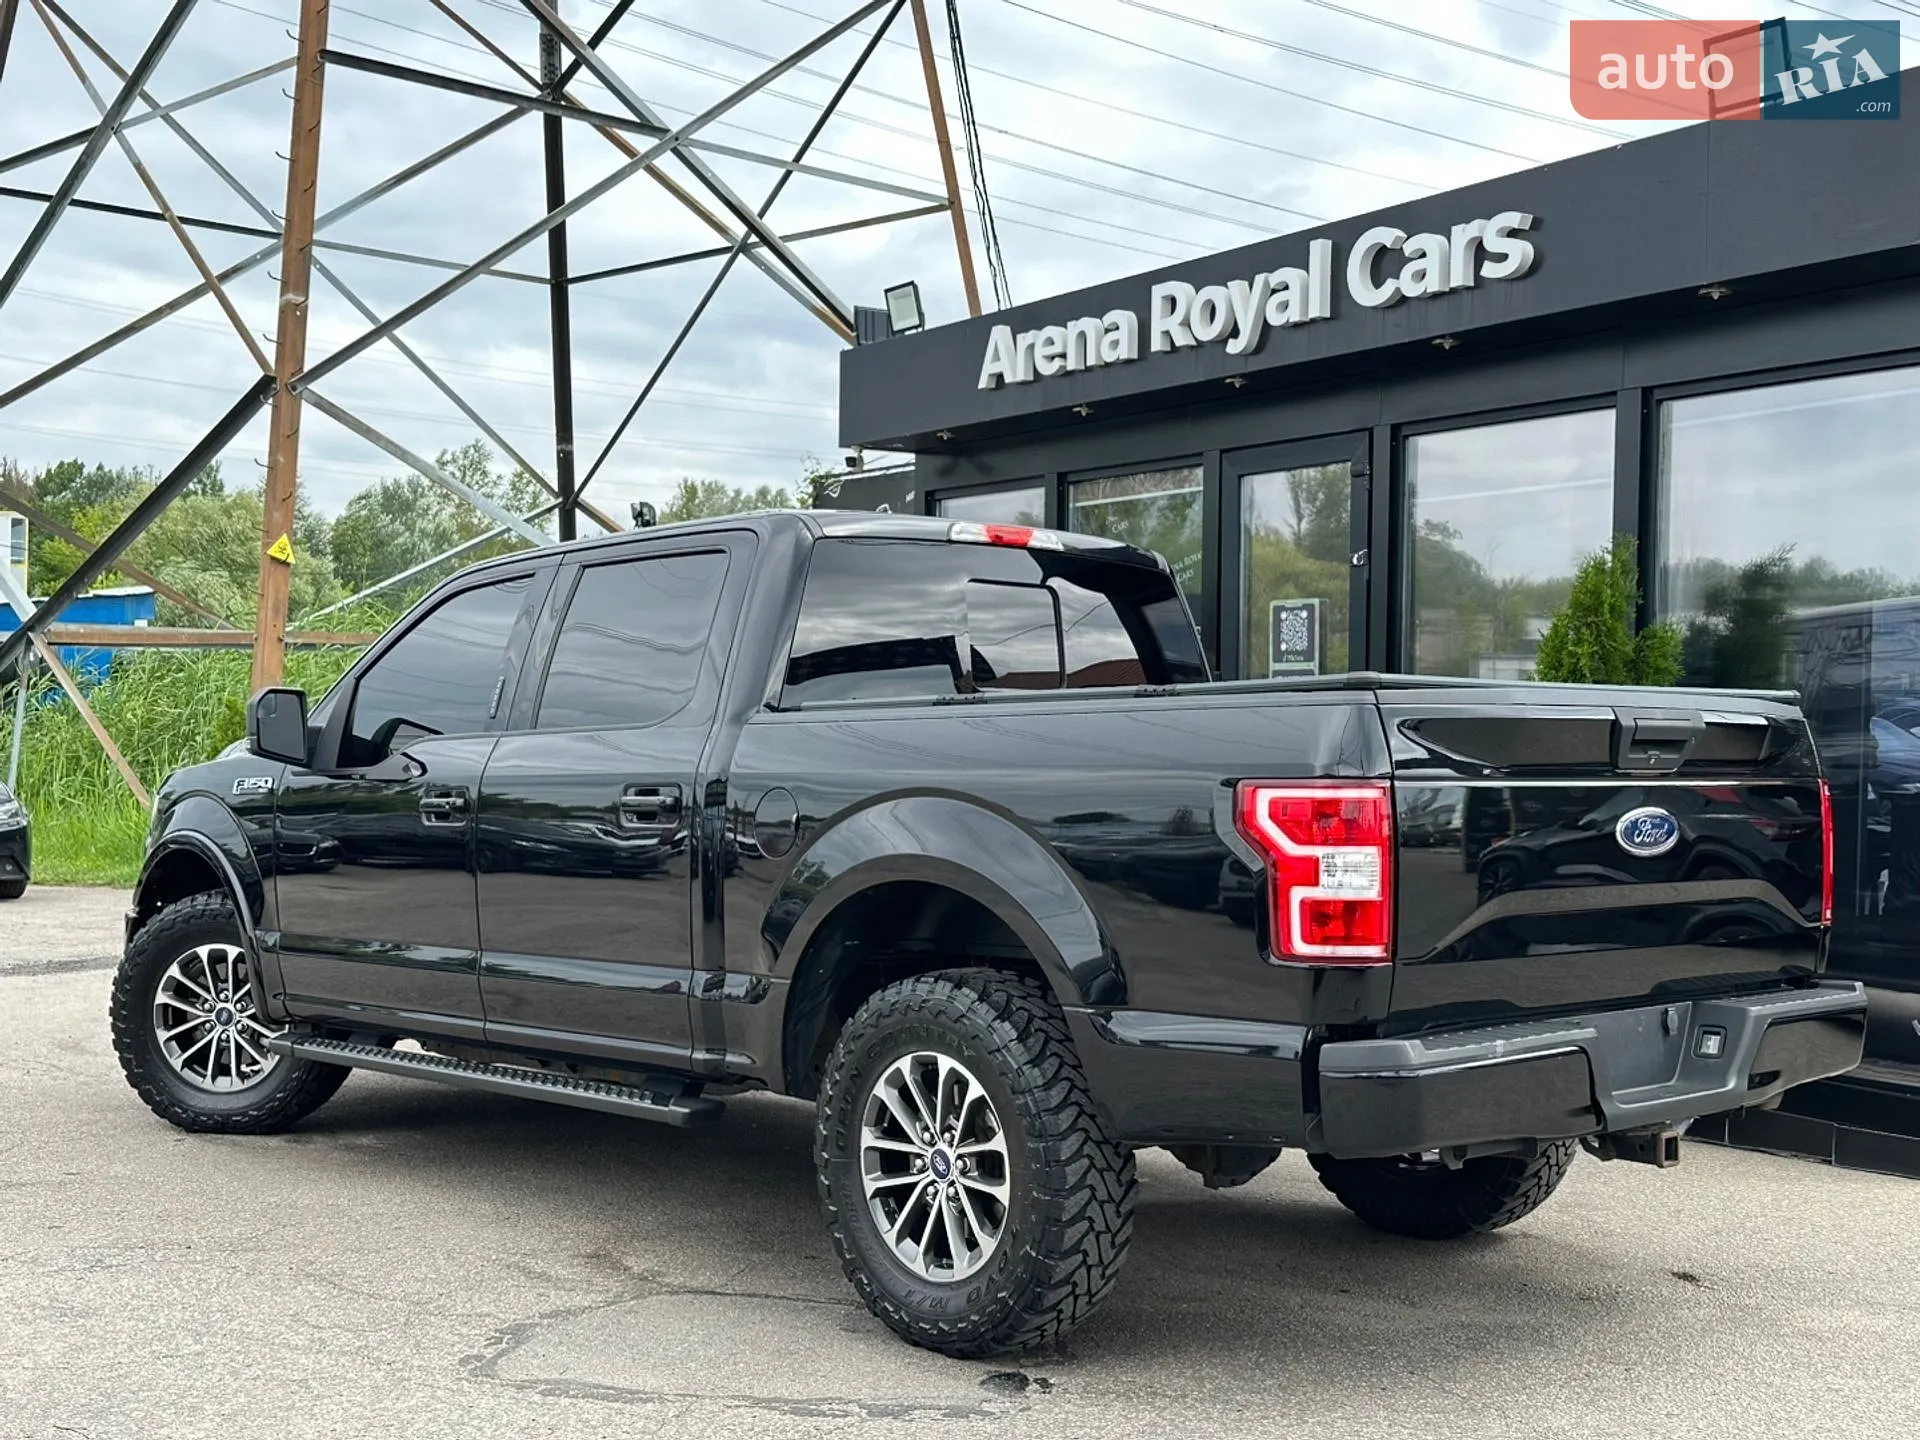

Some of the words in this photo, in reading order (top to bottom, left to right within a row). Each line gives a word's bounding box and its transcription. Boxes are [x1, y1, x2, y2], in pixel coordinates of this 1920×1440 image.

[977, 308, 1138, 390] Arena
[1150, 238, 1332, 355] Royal
[1347, 210, 1535, 308] Cars
[1633, 817, 1668, 843] Ford
